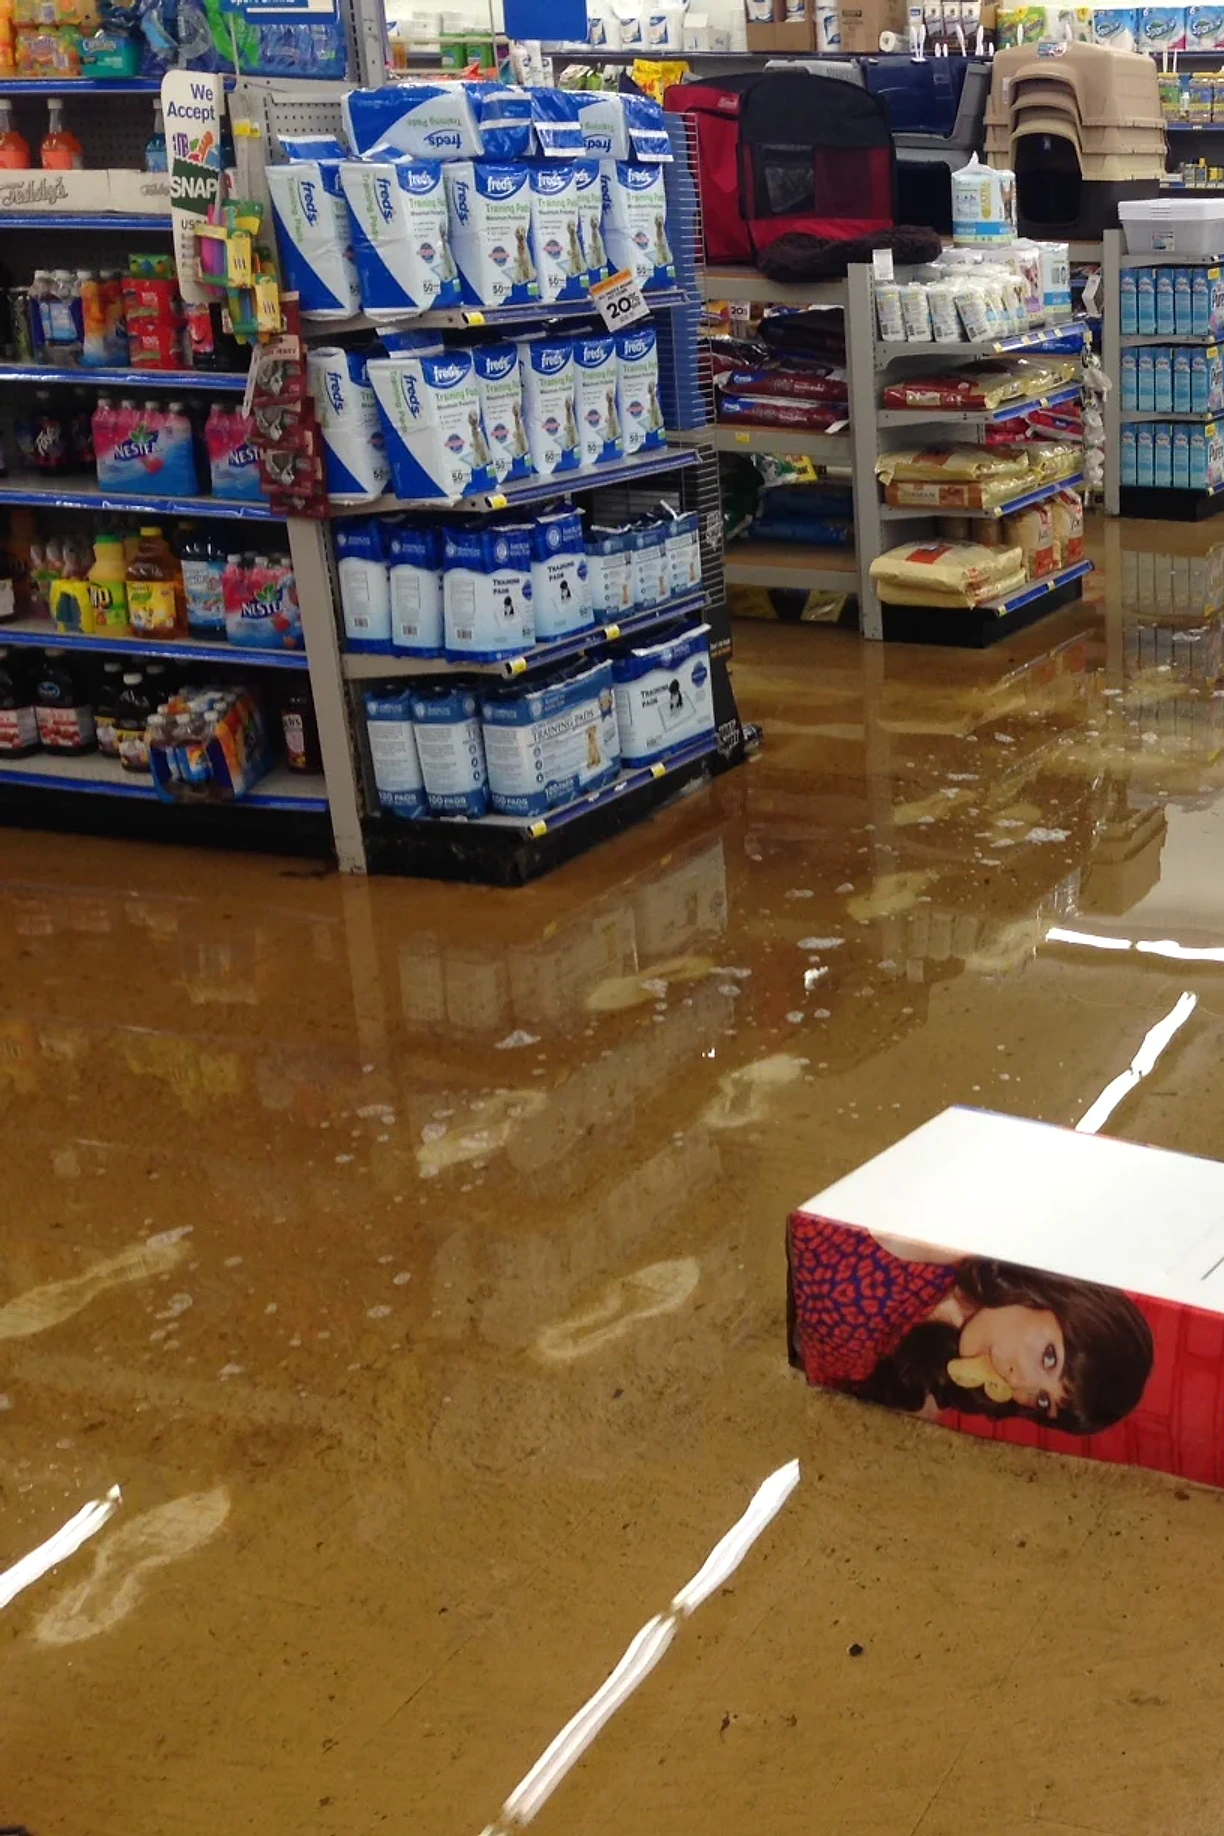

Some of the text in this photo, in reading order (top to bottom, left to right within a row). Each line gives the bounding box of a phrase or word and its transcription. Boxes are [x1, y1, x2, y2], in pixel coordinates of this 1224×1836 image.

[190, 84, 213, 101] We
[167, 102, 216, 123] Accept
[170, 176, 218, 199] SNAP
